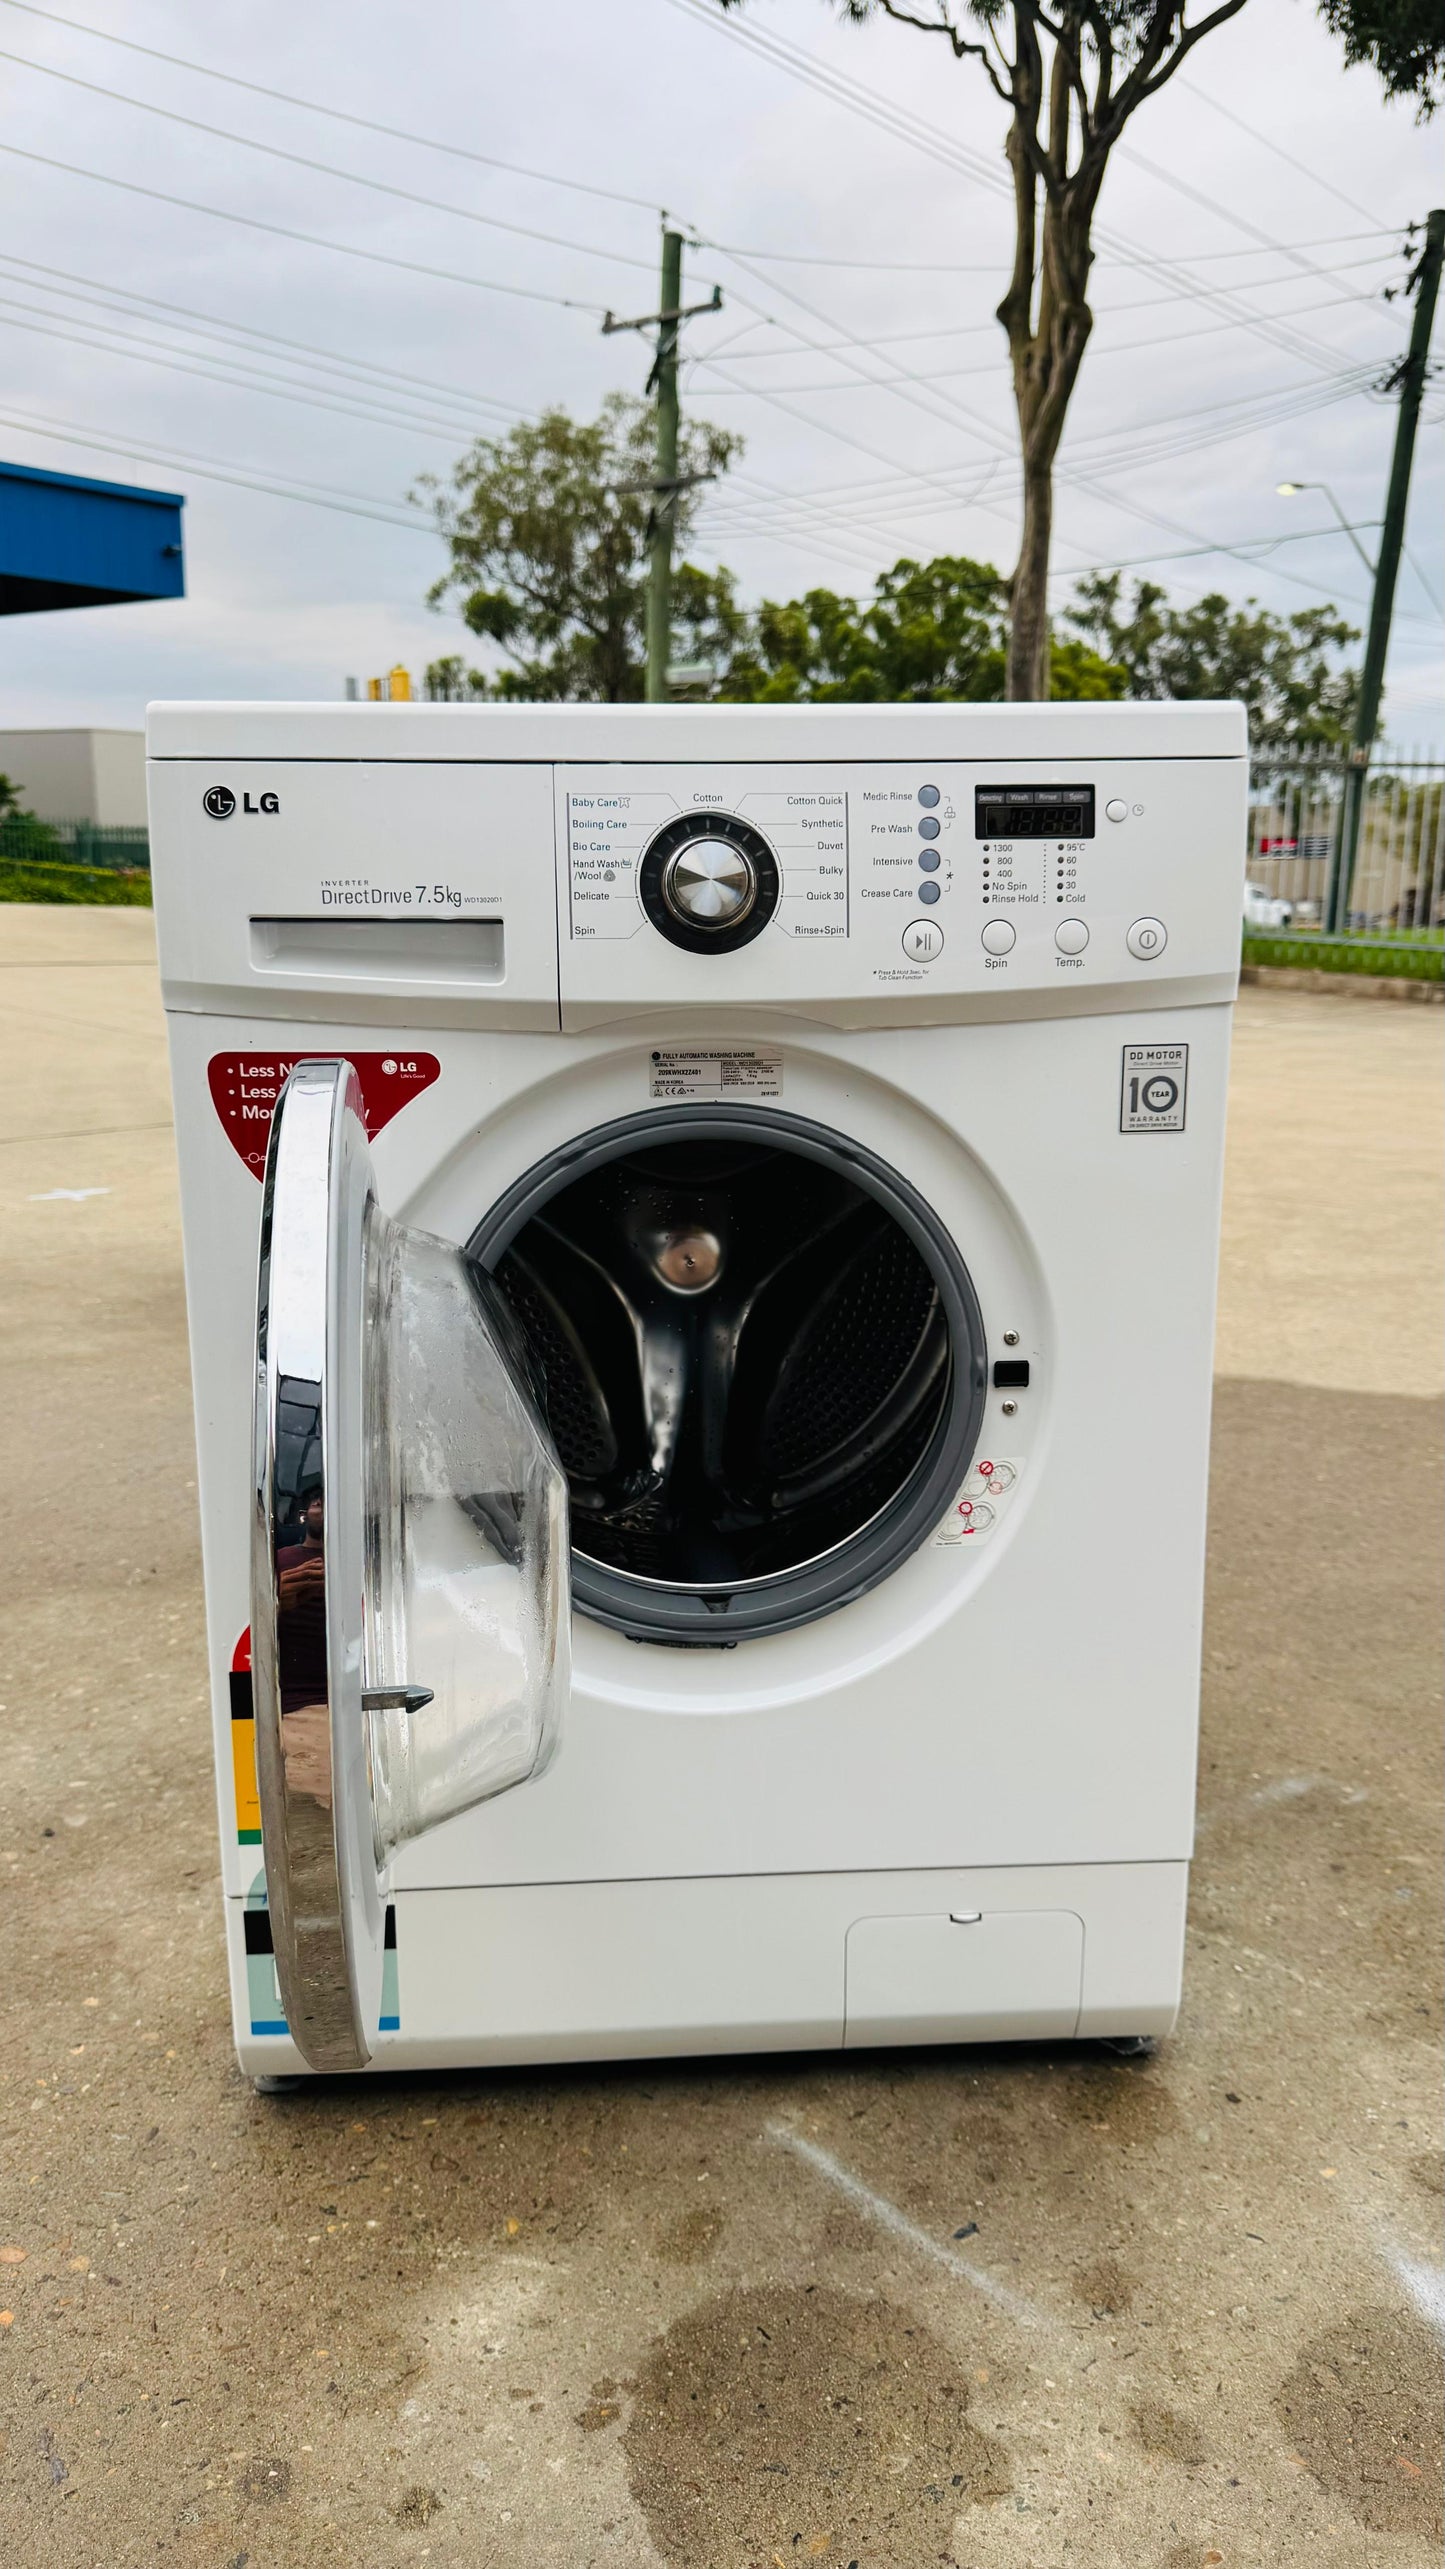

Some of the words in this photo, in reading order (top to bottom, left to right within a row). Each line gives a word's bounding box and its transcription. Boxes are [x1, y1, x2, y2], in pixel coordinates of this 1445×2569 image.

[693, 793, 723, 802] Cotton
[863, 792, 888, 800] Medic
[889, 791, 912, 800] Rinse
[243, 792, 280, 814] LG
[572, 798, 594, 808] Baby
[597, 798, 618, 807] Care
[787, 796, 816, 805] Cotton
[818, 796, 843, 805] Quick
[572, 820, 604, 830] Boiling
[606, 820, 627, 828] Care
[801, 819, 844, 829] Synthetic
[871, 825, 886, 833] Pre
[888, 825, 913, 833] Wash
[573, 842, 588, 851] Bio
[590, 842, 611, 851] Care
[817, 841, 844, 850] Duvet
[993, 844, 1012, 852] 1300
[573, 860, 595, 868] Hand
[596, 859, 620, 868] Wash
[872, 857, 913, 865] Intensive
[1066, 856, 1076, 864] 60
[819, 865, 844, 876] Bulky
[1066, 869, 1076, 877] 40
[574, 872, 602, 880] /Wool
[992, 882, 1005, 890] No
[1007, 882, 1027, 892] Spin
[1065, 881, 1076, 889] 30
[415, 885, 462, 908] 7.5kg
[573, 891, 610, 900] Delicate
[806, 892, 832, 900] Quick
[833, 891, 844, 900] 30
[861, 889, 890, 897] Crease
[892, 889, 913, 897] Care
[991, 894, 1016, 903] Rinse
[1018, 894, 1039, 902] Hold
[1065, 894, 1086, 903] Cold
[574, 926, 595, 937] Spin
[795, 925, 845, 936] Rinse+Spin
[984, 958, 1008, 970] Spin
[1055, 957, 1085, 970] Temp.
[1130, 1051, 1144, 1060] DD
[1147, 1050, 1182, 1060] MOTOR
[239, 1062, 276, 1077] Less
[400, 1062, 417, 1072] LG
[241, 1084, 277, 1098] Less
[1129, 1075, 1178, 1113] 10
